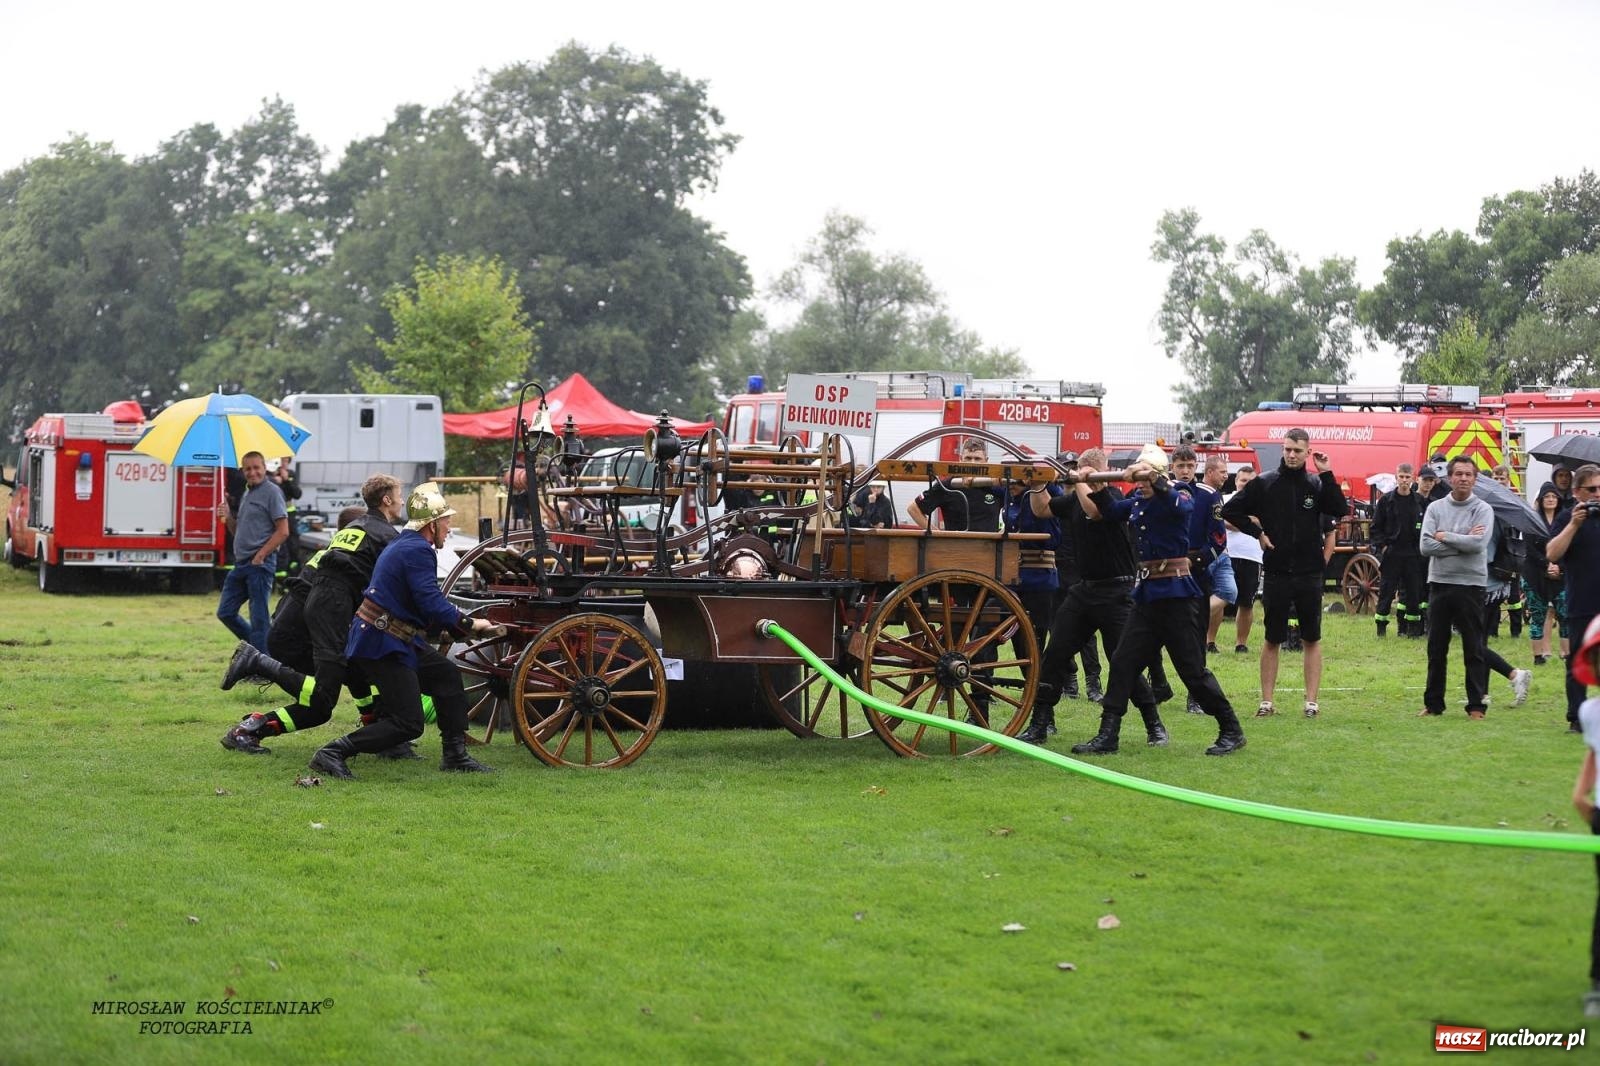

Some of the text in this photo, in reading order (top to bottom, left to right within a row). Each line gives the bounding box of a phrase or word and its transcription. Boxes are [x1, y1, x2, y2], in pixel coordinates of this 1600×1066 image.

[815, 384, 849, 403] OSP
[787, 405, 872, 429] BIENKOWICE
[999, 402, 1050, 422] 428 43
[1073, 432, 1090, 440] 1/23
[115, 462, 167, 482] 428 29
